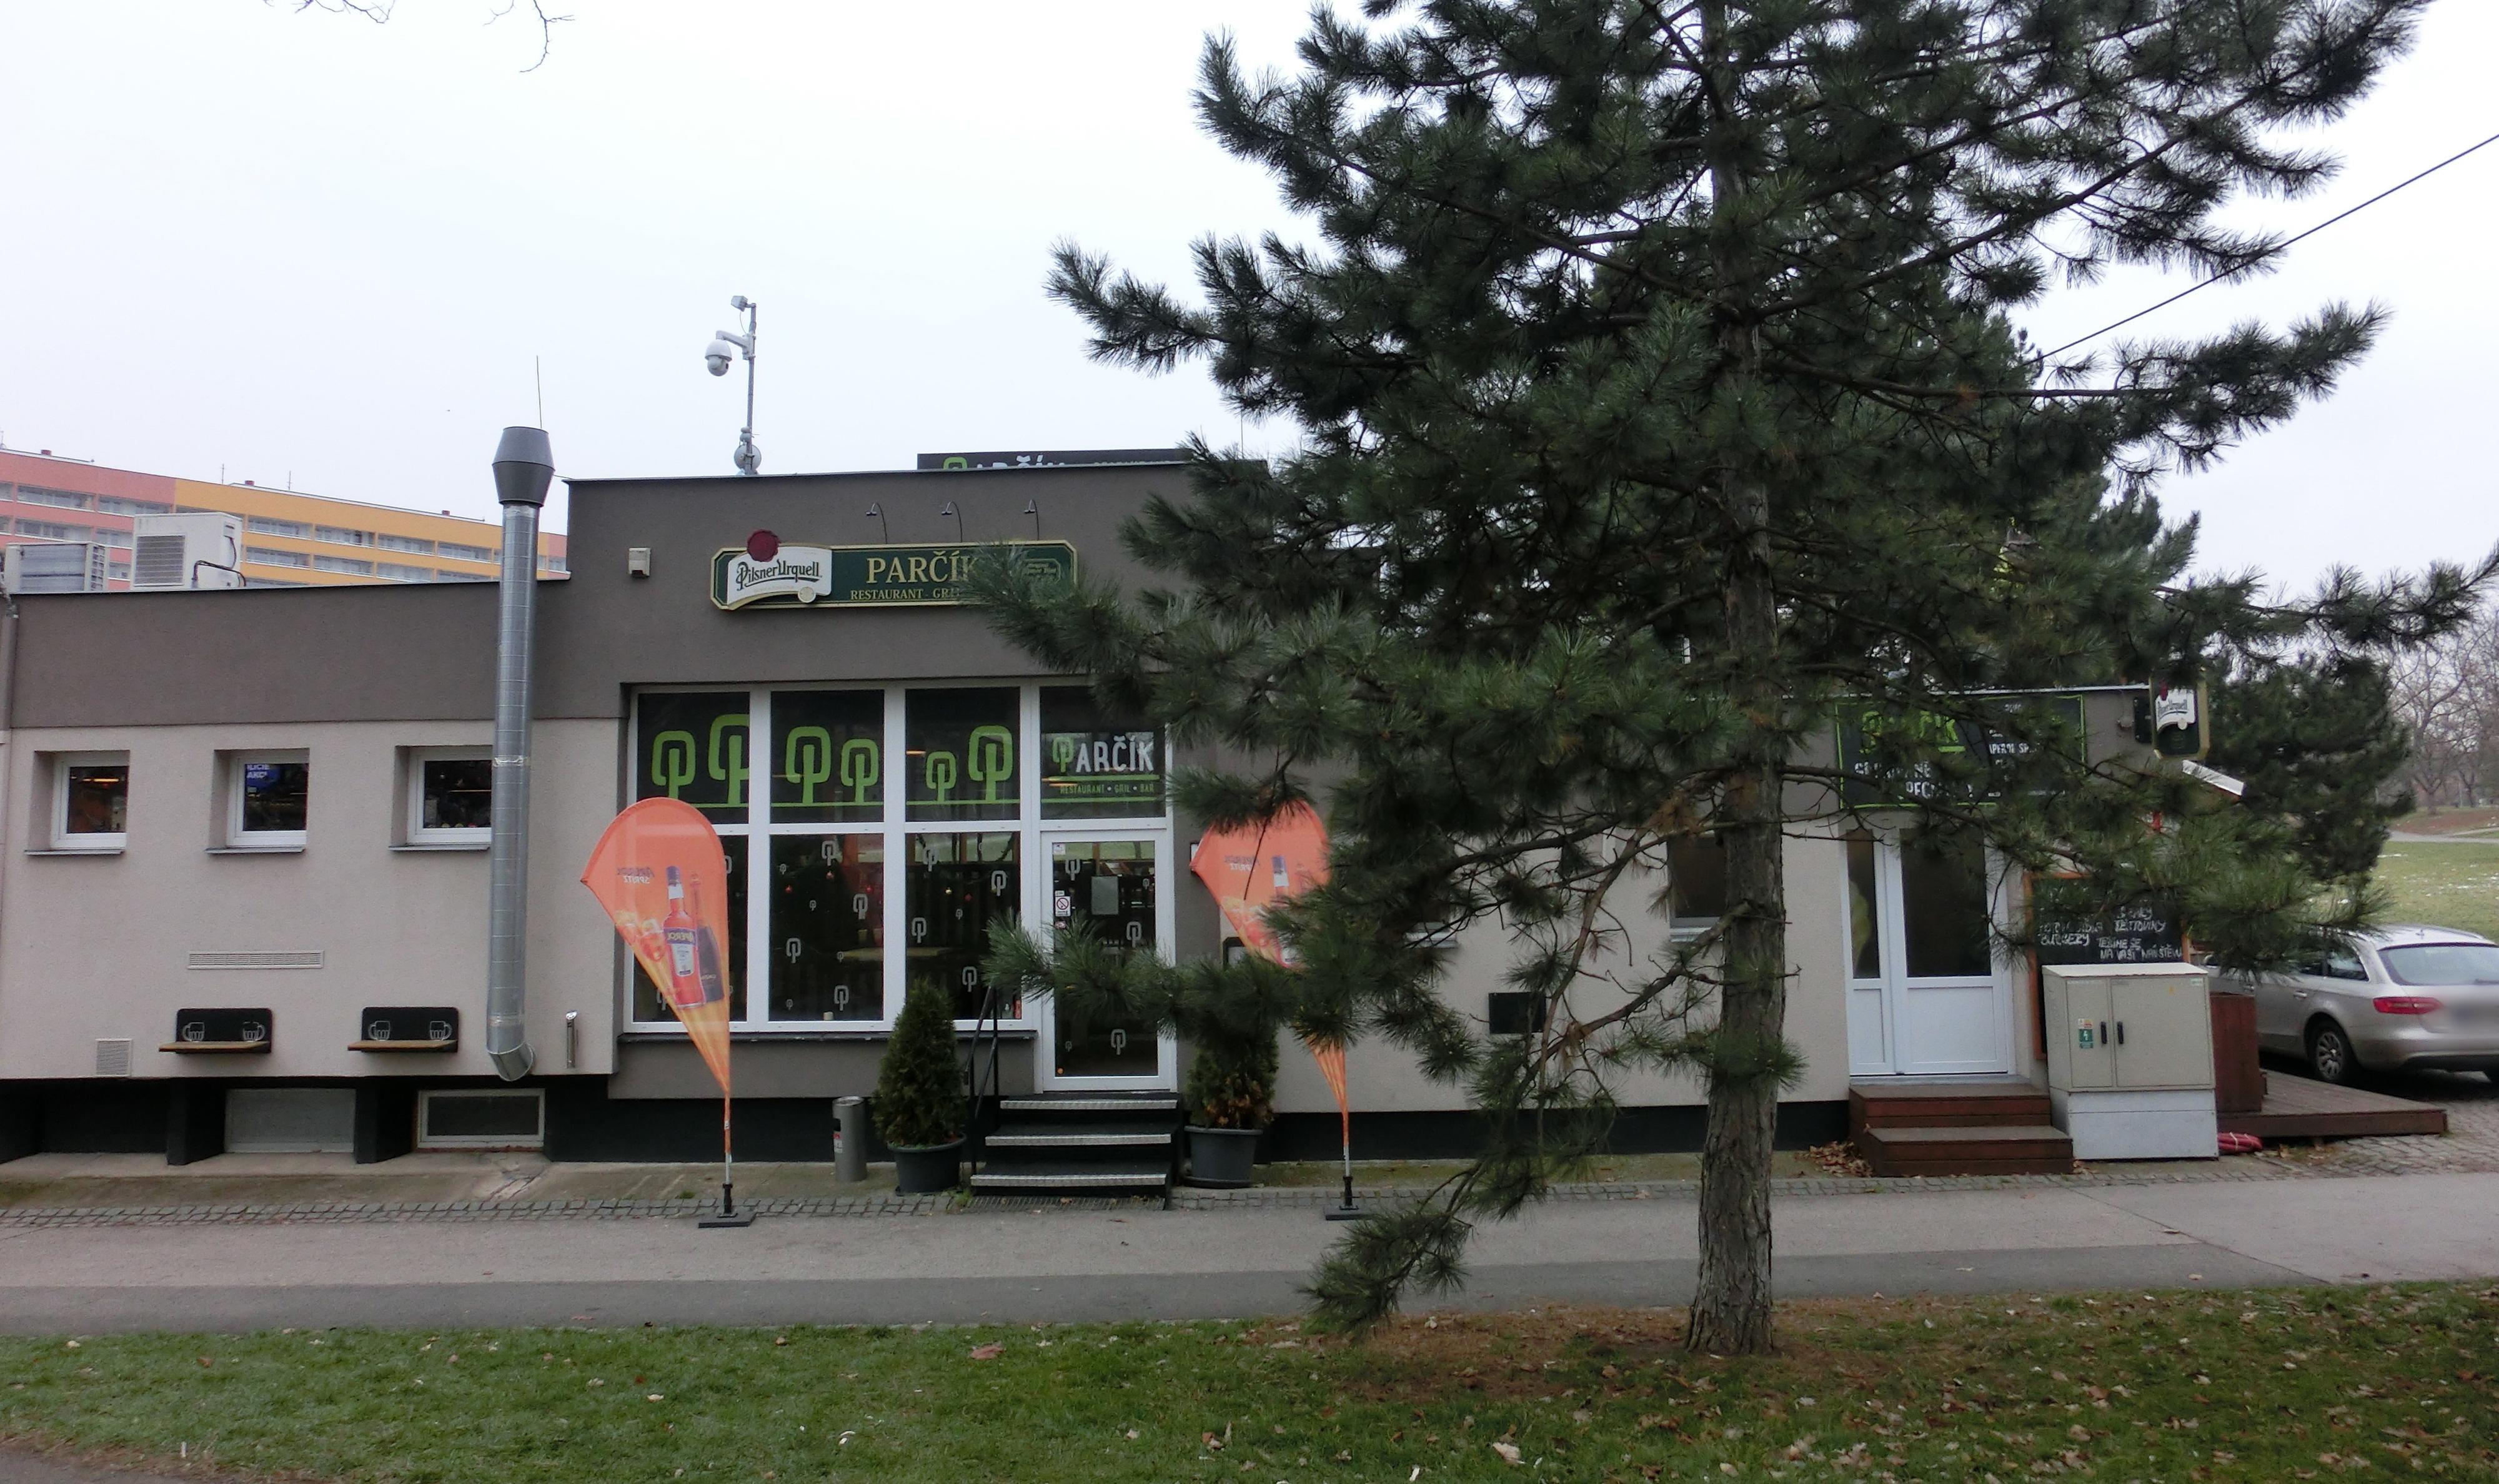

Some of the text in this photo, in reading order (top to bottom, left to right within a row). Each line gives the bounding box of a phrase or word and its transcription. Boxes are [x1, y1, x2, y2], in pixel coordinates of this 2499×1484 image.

[736, 558, 820, 591] Pilsner Urquell
[850, 588, 924, 600] RESTAURANT
[1060, 783, 1155, 794] RESTAURANT GRIL BAR
